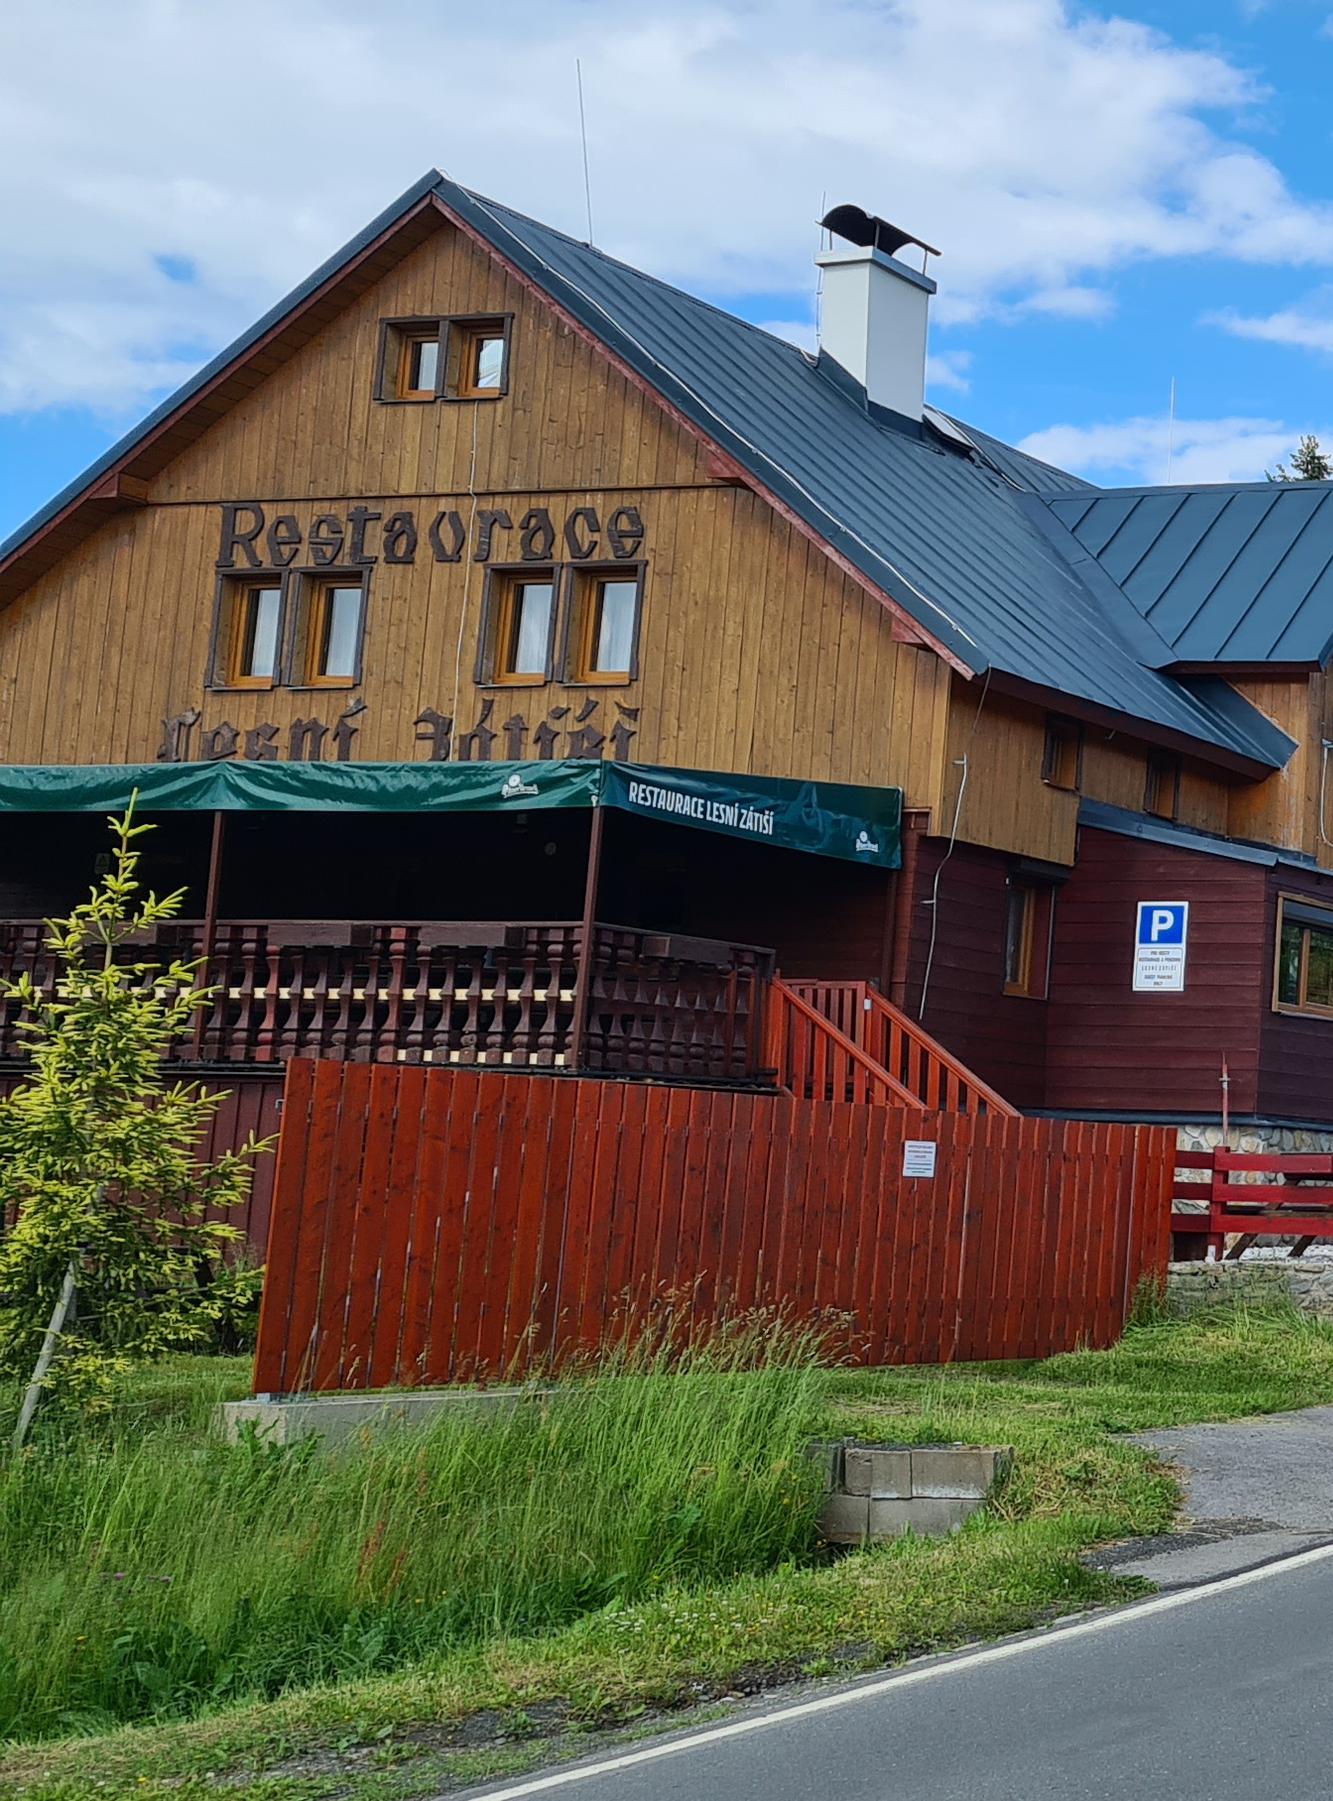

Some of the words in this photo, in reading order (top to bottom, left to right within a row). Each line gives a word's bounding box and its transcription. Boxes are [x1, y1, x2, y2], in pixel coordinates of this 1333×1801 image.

[628, 780, 705, 820] RESTAURACE
[706, 802, 739, 828] LESNÍ
[739, 808, 775, 836] ZÁTIŠÍ
[1151, 910, 1174, 942] P
